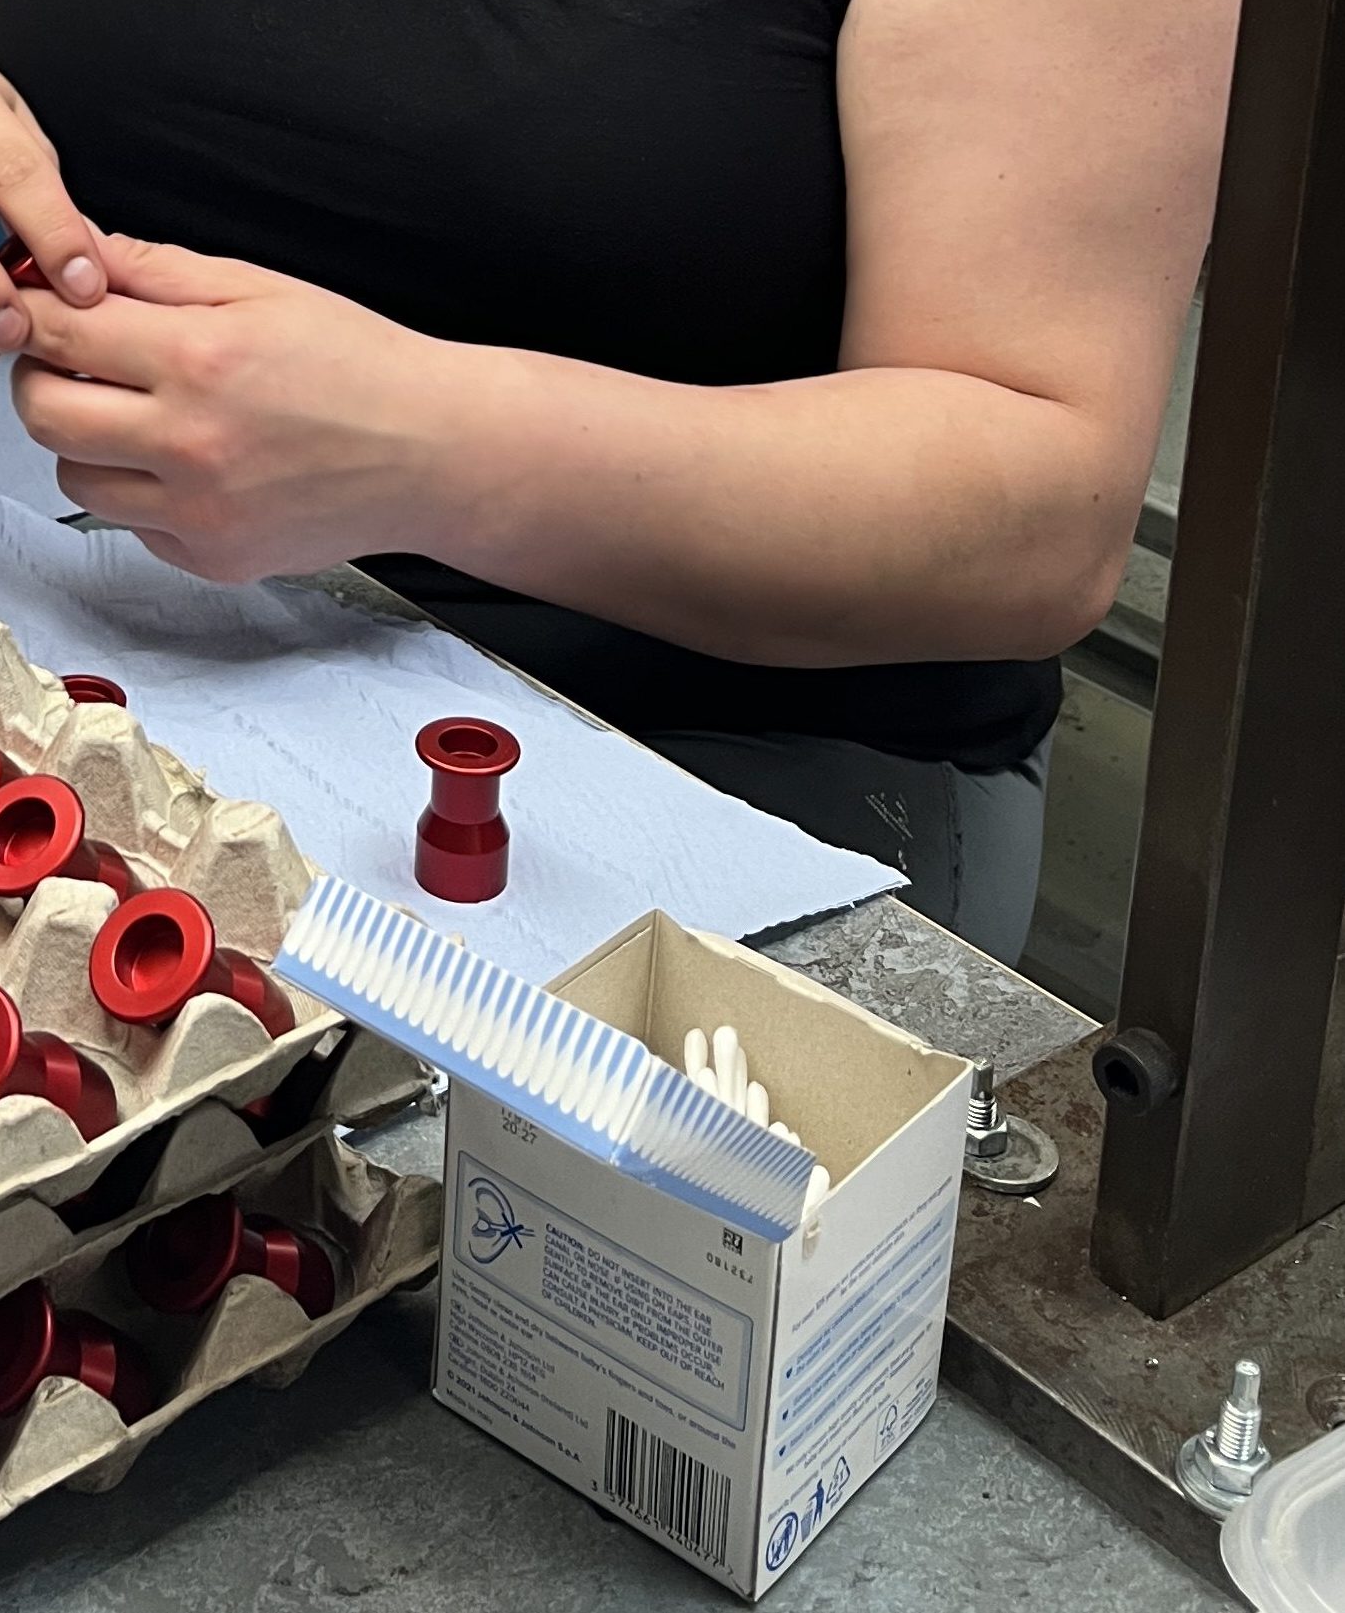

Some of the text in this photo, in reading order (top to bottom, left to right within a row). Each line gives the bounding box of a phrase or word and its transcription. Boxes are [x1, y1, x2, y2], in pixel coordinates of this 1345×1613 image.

[542, 1287, 551, 1301] OF
[542, 1276, 578, 1306] CONSULT
[580, 1298, 586, 1311] A
[636, 1331, 657, 1354] KEEP
[660, 1346, 677, 1366] OUT
[679, 1357, 692, 1374] OF
[694, 1366, 724, 1392] REACH
[543, 1265, 559, 1283] CAN
[561, 1276, 586, 1300] CAUSE
[623, 1312, 629, 1325] IF
[632, 1318, 677, 1354] PROBLEMS
[544, 1244, 723, 1356] GENTLY TO REMOVE DIRT FROM THE OUTER
[544, 1254, 577, 1283] SURFACE
[581, 1275, 591, 1291] OF
[595, 1284, 608, 1301] THE
[612, 1294, 628, 1313] EAR
[656, 1320, 701, 1356] IMPROPER
[704, 1347, 721, 1366] USE
[545, 1233, 569, 1256] CANAL
[573, 1249, 584, 1265] OR
[614, 1273, 620, 1285] IF
[623, 1278, 649, 1303] USING
[652, 1295, 664, 1311] ON
[694, 1319, 711, 1338] USE
[588, 1246, 599, 1262] DO
[602, 1255, 618, 1273] NOT
[622, 1266, 649, 1291] INSERT
[652, 1284, 672, 1304] INTO
[675, 1297, 691, 1314] THE
[694, 1308, 711, 1326] EAR
[456, 1373, 475, 1395] 2021
[515, 1310, 528, 1327] and
[637, 1386, 652, 1403] and
[689, 1417, 718, 1442] around
[722, 1435, 735, 1451] the
